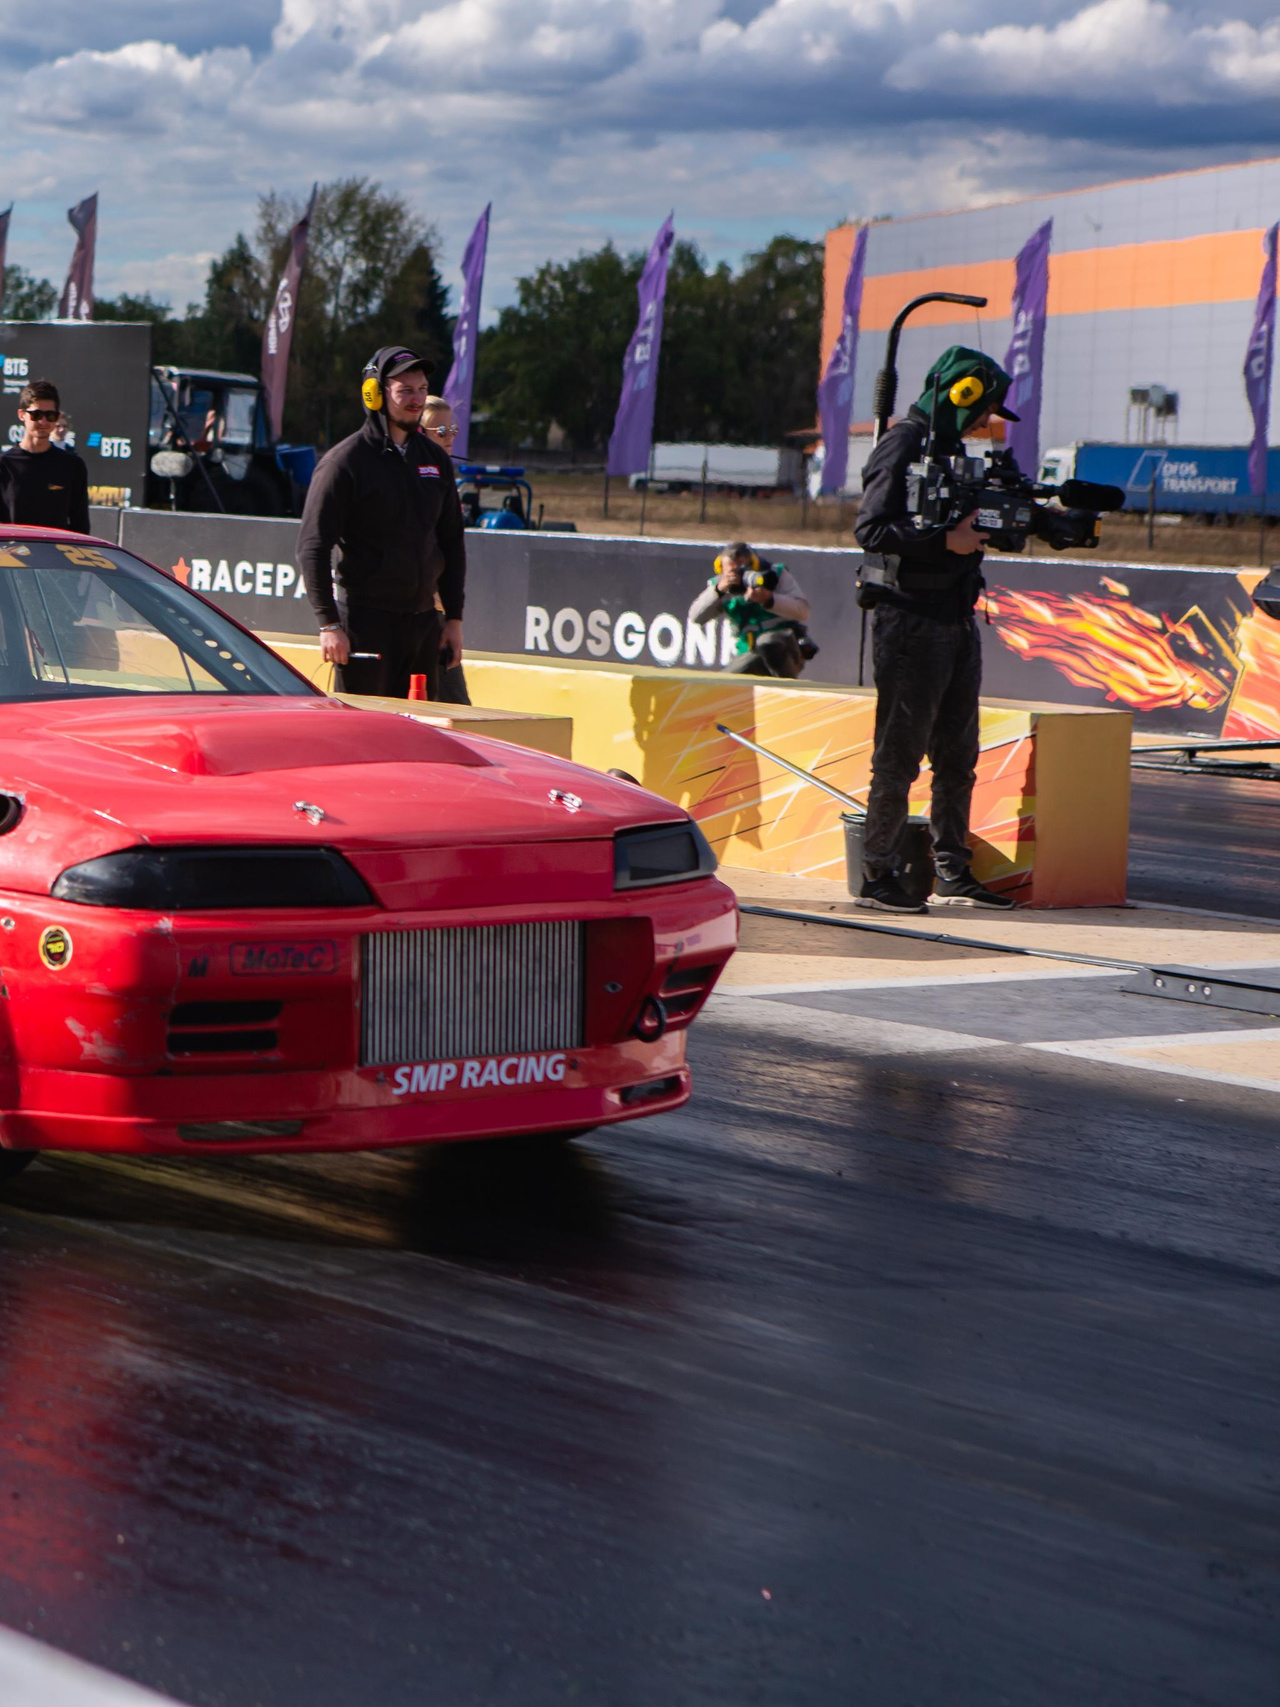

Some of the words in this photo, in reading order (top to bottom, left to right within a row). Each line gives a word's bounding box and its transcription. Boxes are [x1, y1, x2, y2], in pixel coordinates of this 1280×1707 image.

[3, 358, 29, 377] ВТБ
[100, 437, 132, 459] ВТБ
[1162, 477, 1239, 494] TRANSPORT
[56, 544, 118, 570] 25
[242, 946, 327, 971] MoTeC
[392, 1063, 458, 1096] SMP
[460, 1053, 567, 1090] RACING
